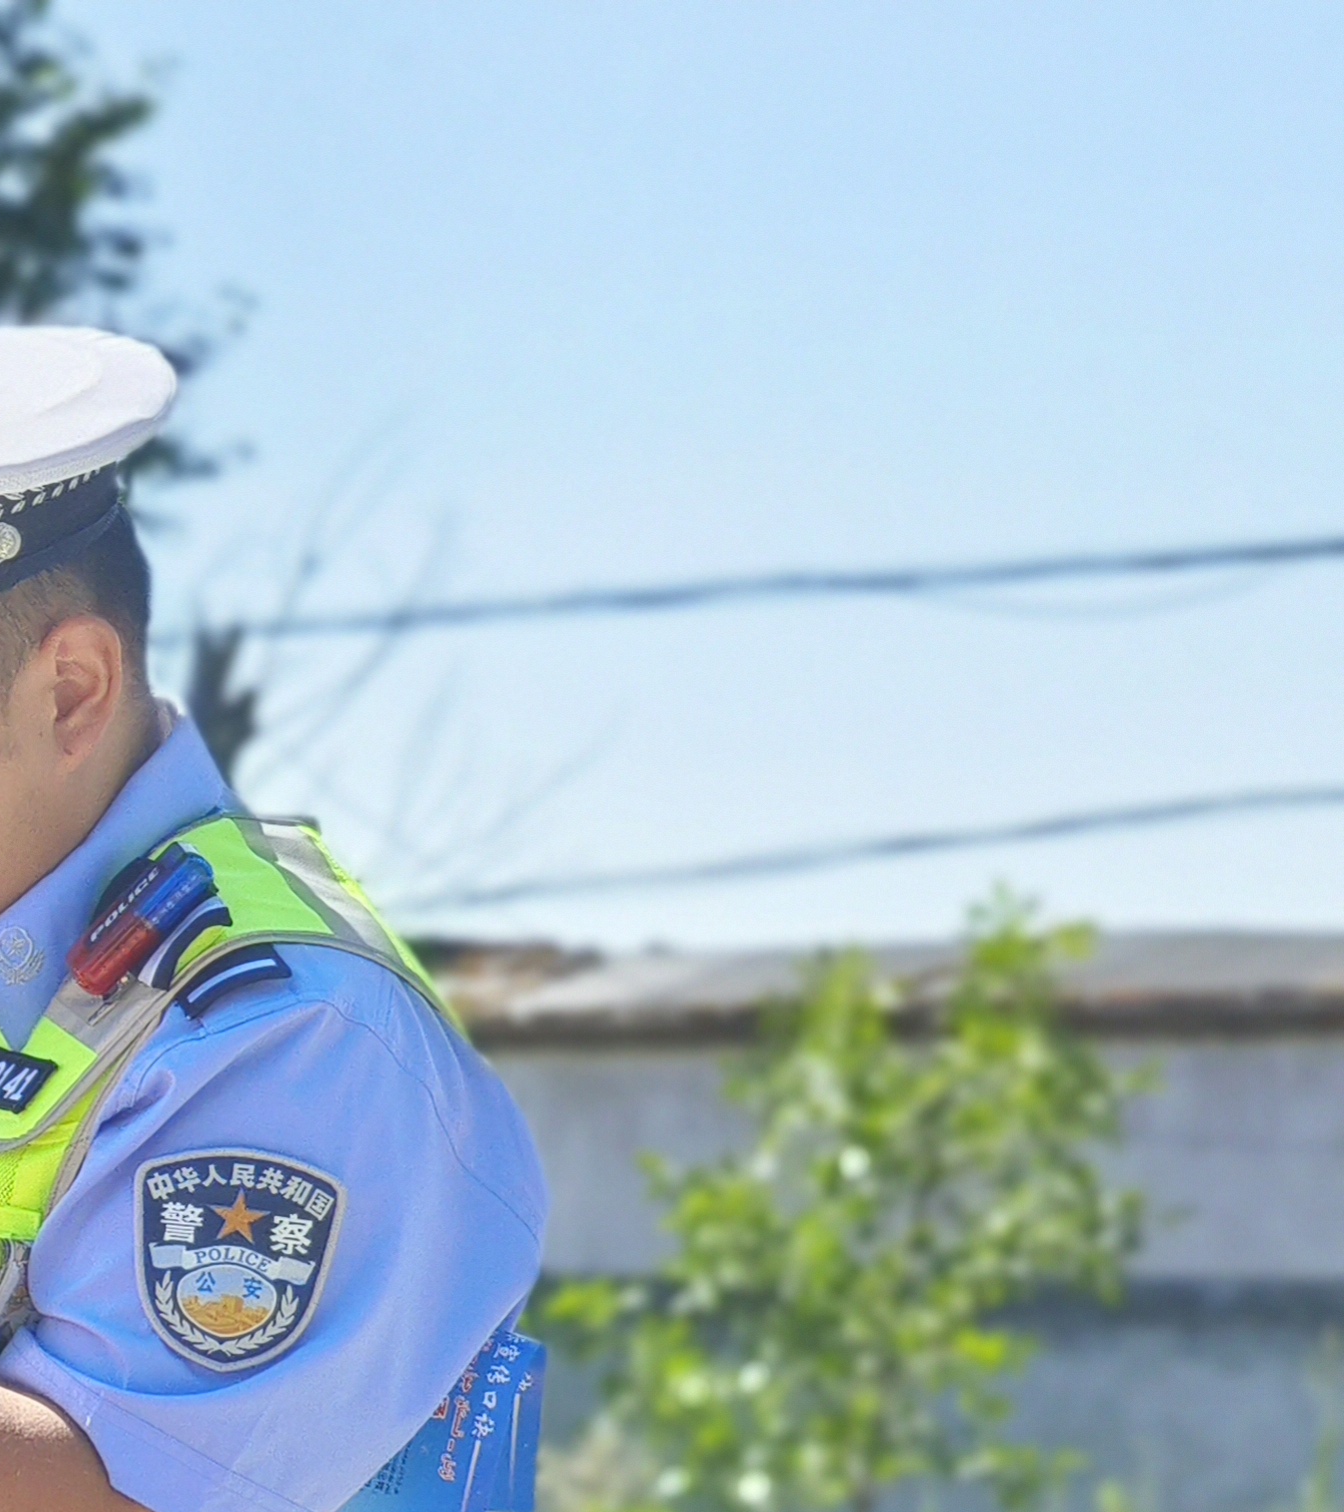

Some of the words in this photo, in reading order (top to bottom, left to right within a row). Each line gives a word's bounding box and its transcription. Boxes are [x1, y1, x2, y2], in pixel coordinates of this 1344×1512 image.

[90, 866, 160, 942] POLICE
[147, 1163, 334, 1221] 中华人民共和国
[160, 1201, 313, 1255] 警察
[195, 1247, 271, 1273] POLICE
[195, 1271, 262, 1300] 公安
